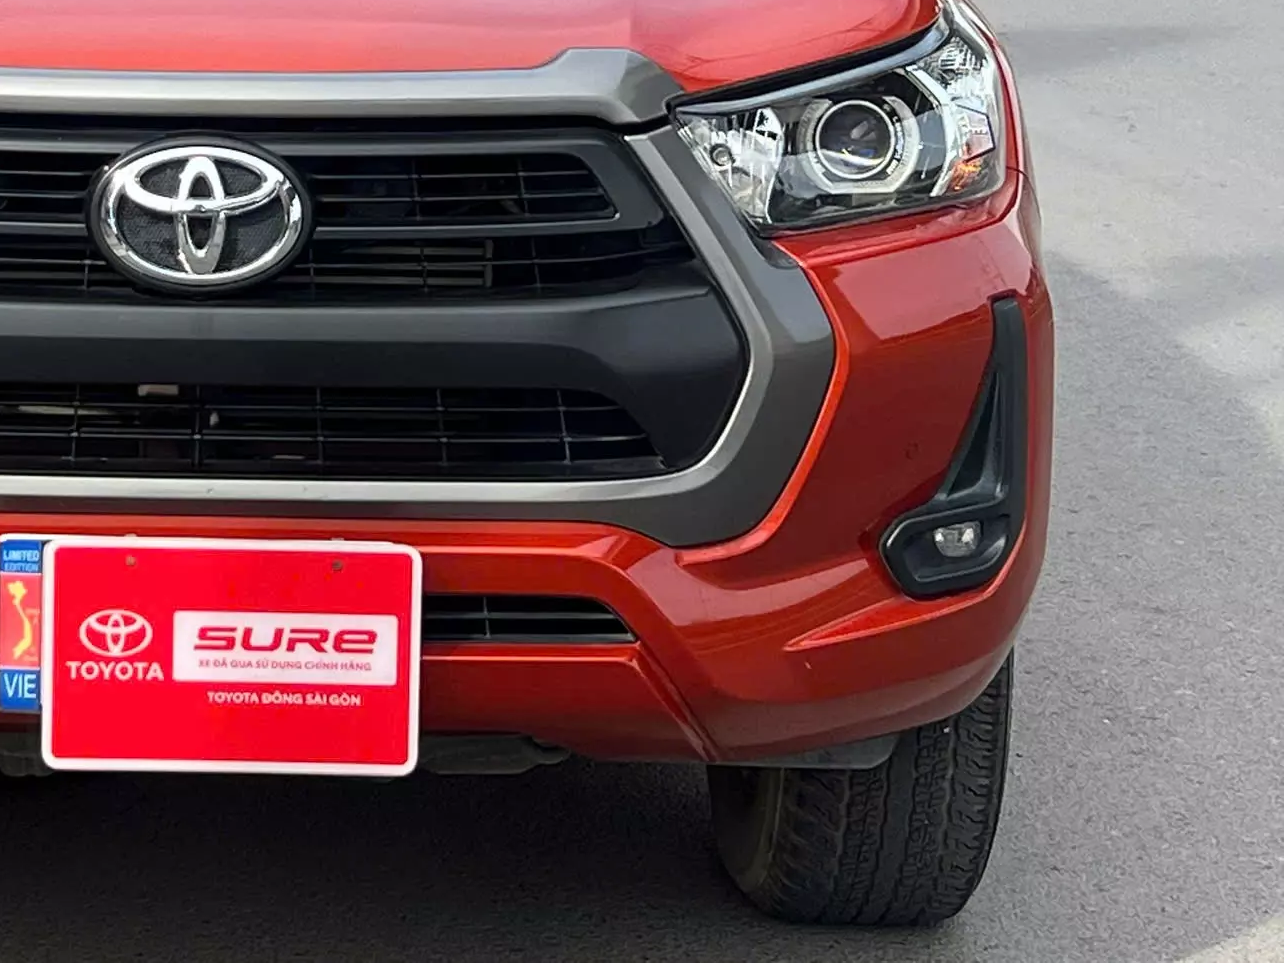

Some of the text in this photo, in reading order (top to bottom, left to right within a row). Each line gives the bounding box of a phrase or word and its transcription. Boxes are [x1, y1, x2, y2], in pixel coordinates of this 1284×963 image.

[65, 660, 165, 681] TOYOTA
[3, 673, 37, 699] VIE
[207, 691, 259, 705] TOYOTA
